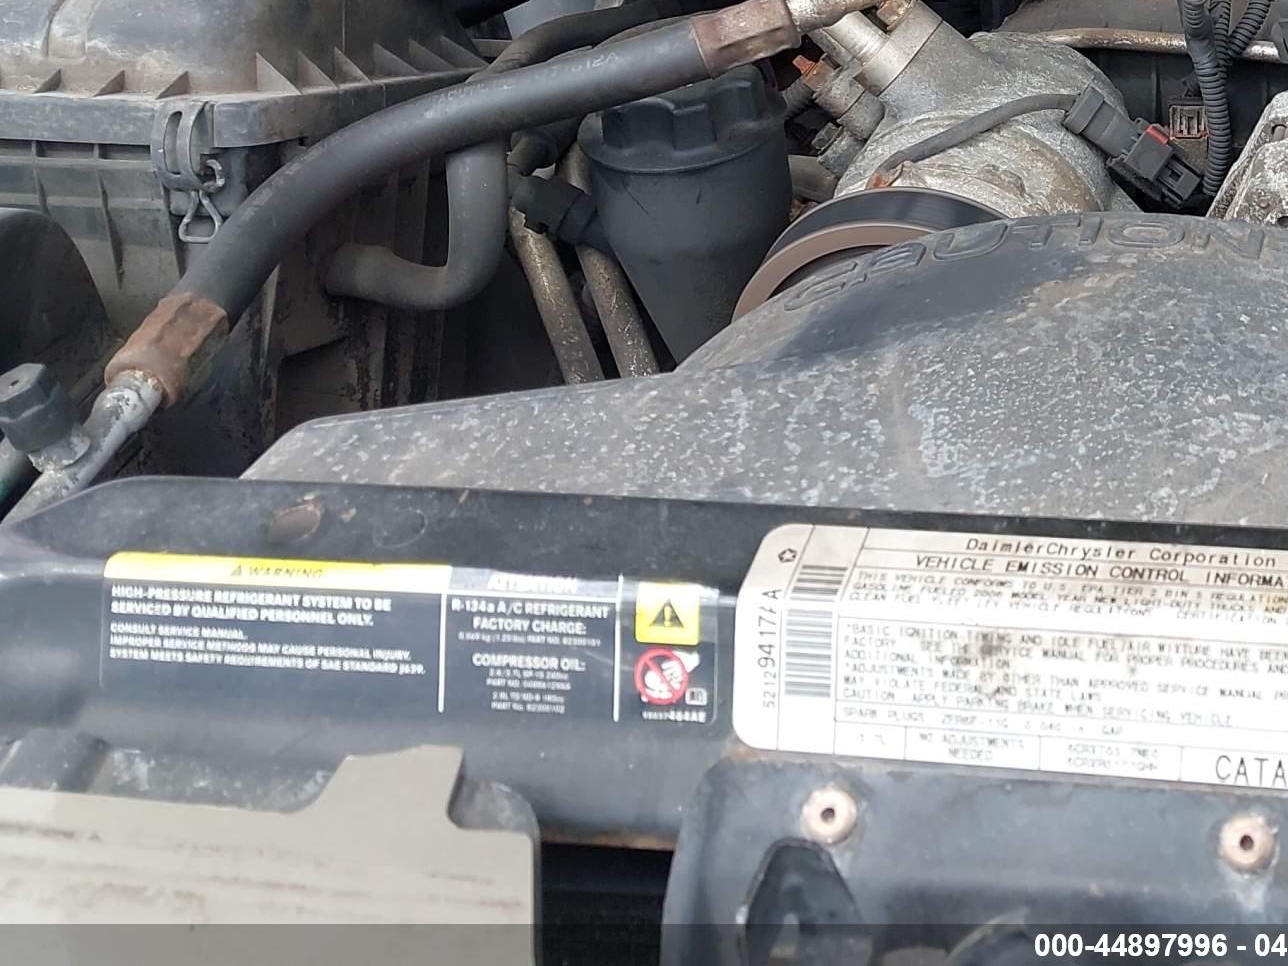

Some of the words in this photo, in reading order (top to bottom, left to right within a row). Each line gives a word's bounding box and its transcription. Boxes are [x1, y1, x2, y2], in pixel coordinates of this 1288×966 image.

[784, 212, 1266, 312] CAUTION
[966, 538, 1136, 560] DaimlerChrysler
[1149, 547, 1275, 567] Corporation
[249, 565, 324, 579] WARNING
[916, 554, 994, 571] VEHICLE
[1005, 559, 1098, 576] EMISSION
[1110, 565, 1187, 581] CONTROL
[487, 575, 578, 594] ATTENTION
[859, 571, 888, 581] THIS
[896, 573, 946, 584] VEHICLE
[1114, 586, 1143, 595] TIER
[111, 584, 213, 603] HIGH-PRESSURE
[214, 590, 301, 607] REFRIGERANT
[302, 594, 353, 610] SYSTEM
[354, 597, 373, 611] TO
[374, 598, 392, 611] BE
[1058, 594, 1087, 602] YEAR
[111, 600, 172, 617] SERVICED
[172, 603, 190, 618] BY
[191, 604, 259, 621] QUALIFIED
[260, 608, 336, 624] PERSONNEL
[337, 612, 374, 626] ONLY.
[451, 599, 495, 614] R-134a
[525, 602, 610, 619] REFRIGERANT
[110, 622, 157, 635] CONSULT
[158, 624, 200, 637] SERVICE
[473, 617, 530, 632] FACTORY
[532, 620, 587, 635] CHARGE:
[110, 634, 162, 648] IMPROPER
[258, 643, 281, 655] MAY
[282, 644, 316, 656] CAUSE
[317, 646, 372, 659] PERSONAL
[899, 626, 958, 640] IGNITION
[1020, 634, 1042, 645] AND
[1051, 636, 1079, 647] IDLE
[110, 647, 149, 660] SYSTEM
[150, 649, 184, 662] MEETS
[185, 652, 223, 665] SAFETY
[343, 661, 398, 674] STANDARD
[472, 653, 558, 670] COMPRESSOR
[560, 658, 586, 672] OIL:
[981, 643, 1030, 657] RVICE
[1042, 648, 1086, 662] MANUAL
[1096, 650, 1120, 663] FOR
[843, 675, 865, 685] MAY
[1050, 674, 1079, 687] THAN
[948, 747, 993, 761] NEEDED
